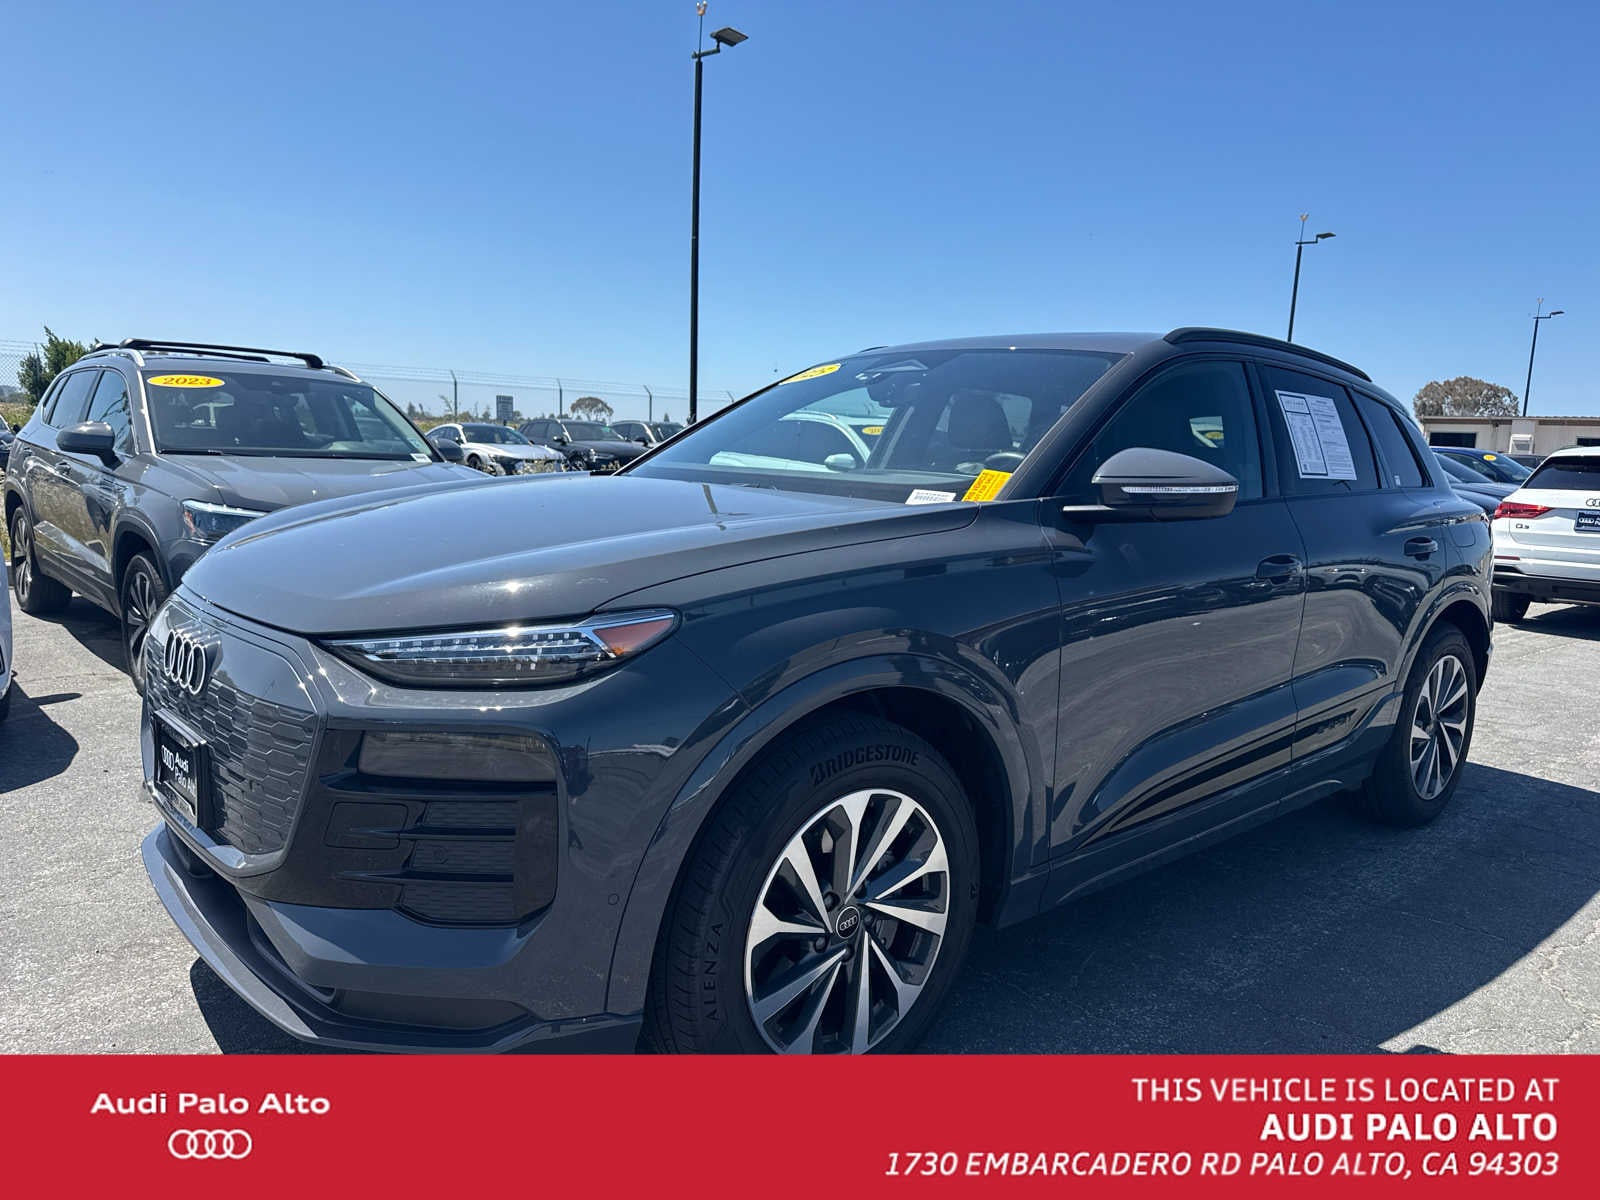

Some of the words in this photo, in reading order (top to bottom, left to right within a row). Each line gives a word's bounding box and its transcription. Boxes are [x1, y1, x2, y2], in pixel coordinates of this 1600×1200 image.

[163, 377, 212, 385] 2023
[175, 751, 189, 773] Audi
[808, 745, 921, 786] BRIDGESTONE
[703, 923, 723, 1021] ALENZA
